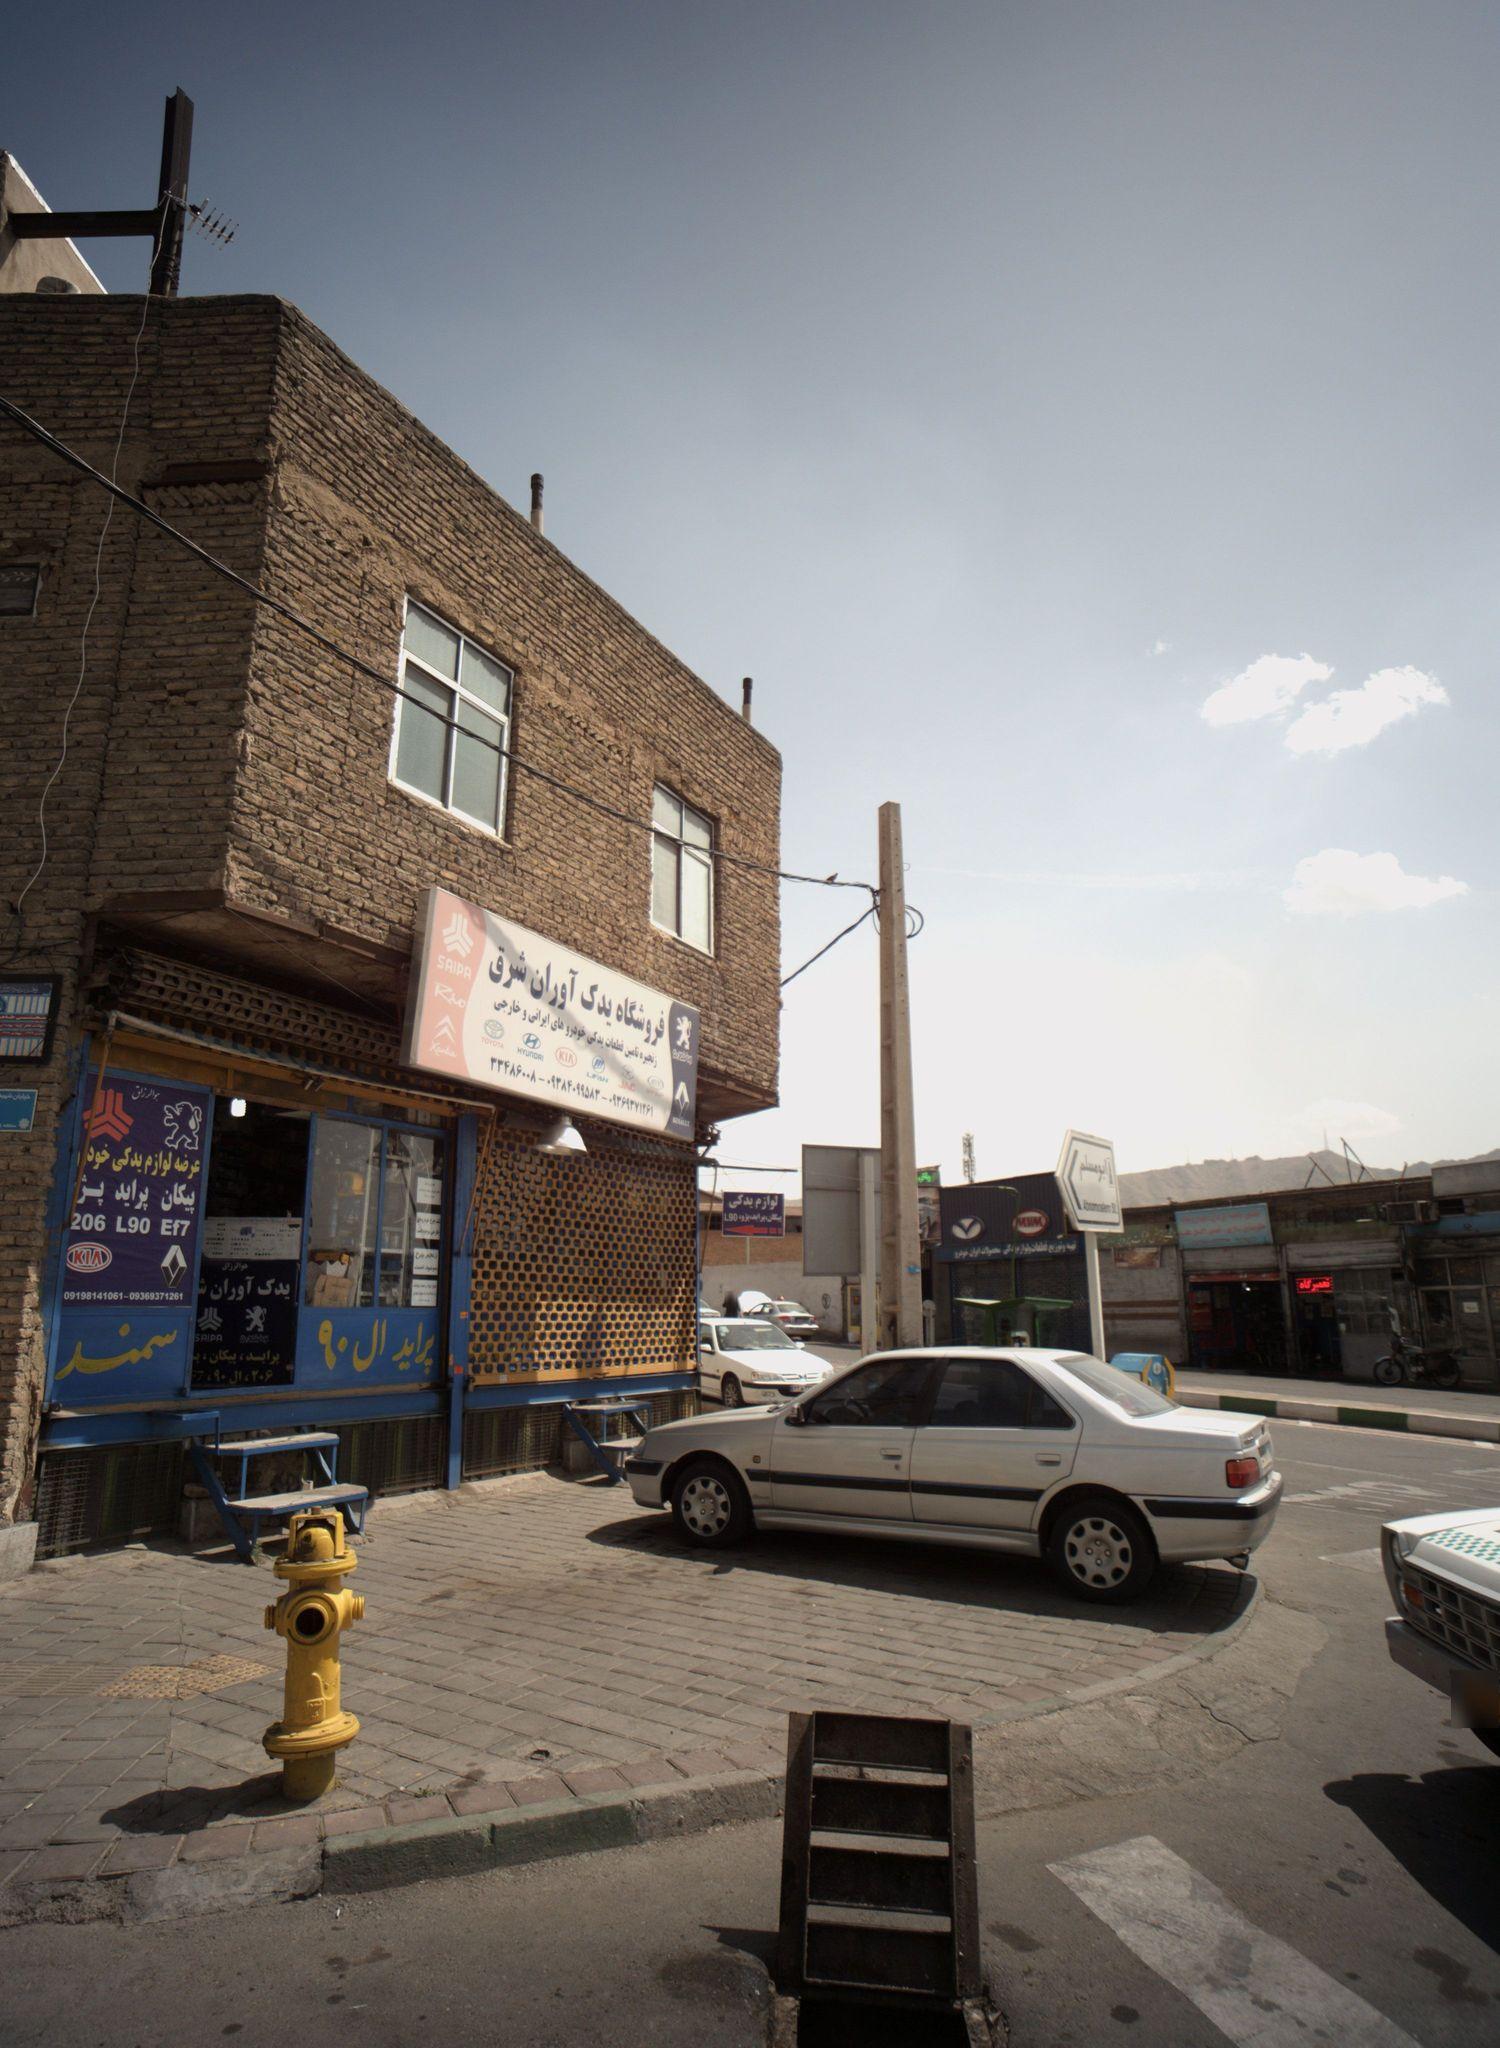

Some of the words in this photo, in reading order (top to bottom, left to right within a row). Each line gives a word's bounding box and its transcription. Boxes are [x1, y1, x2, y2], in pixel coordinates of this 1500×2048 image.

[437, 954, 472, 979] SAIPA
[489, 946, 527, 989] شرق
[530, 962, 579, 1010] آوران
[493, 1000, 521, 1016] خارجی
[528, 1008, 551, 1028] ایرانی
[581, 984, 613, 1027] یدک
[616, 997, 665, 1047] فروشگاه
[517, 1047, 545, 1062] HYUNDAI
[559, 1051, 575, 1065] KIA
[77, 1143, 110, 1170] خود
[112, 1146, 143, 1172] یدکی
[144, 1150, 172, 1177] لوازم
[174, 1154, 200, 1180] عرضه
[115, 1179, 149, 1210] پراید
[161, 1182, 196, 1214] پیکان
[728, 1194, 753, 1209] یدکی
[755, 1195, 778, 1210] لوازم
[70, 1213, 106, 1232] 206
[116, 1216, 151, 1234] L90
[160, 1219, 190, 1237] Ef7
[73, 1248, 104, 1266] KIA
[210, 1276, 255, 1301] آوران
[257, 1278, 291, 1300] یدک
[195, 1333, 223, 1343] SAIPA
[318, 1319, 349, 1371] ۹۰
[352, 1318, 387, 1372] ال
[391, 1321, 436, 1376] پراید
[54, 1323, 178, 1380] سمند
